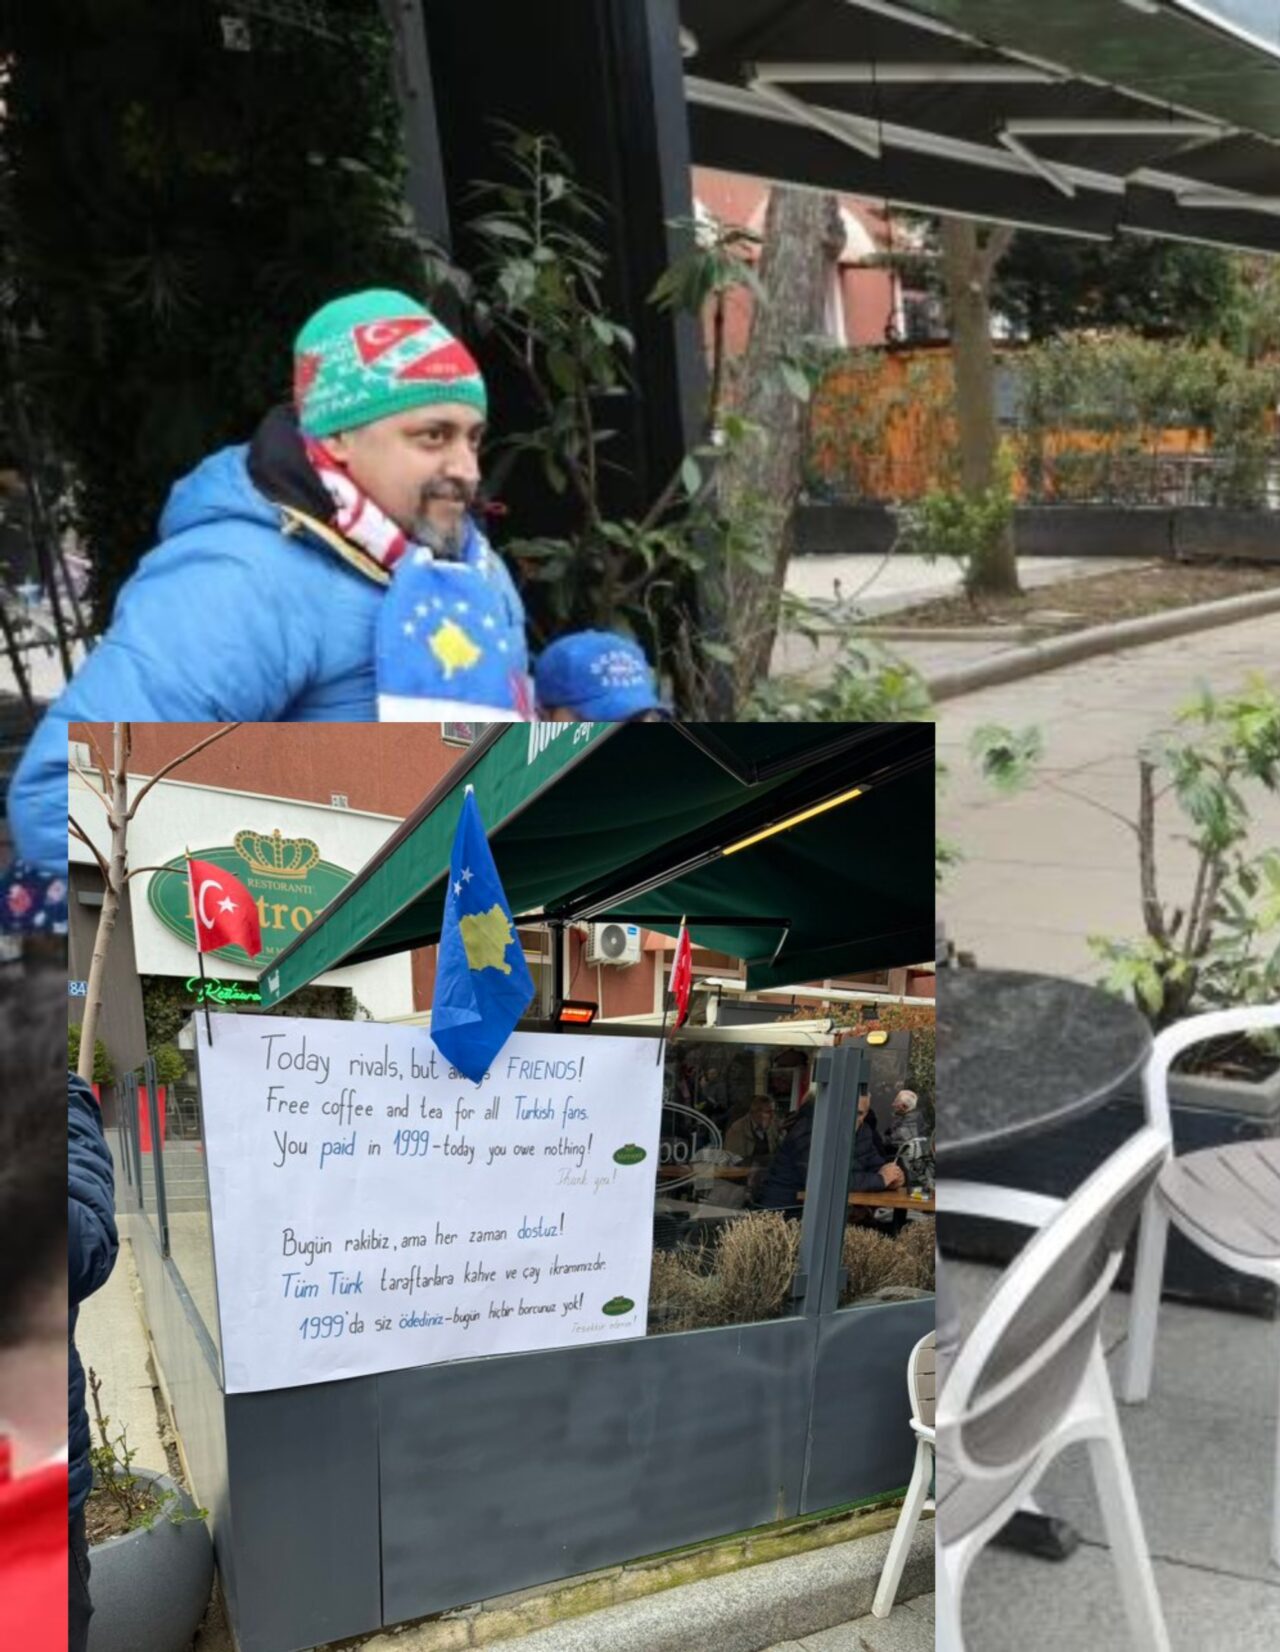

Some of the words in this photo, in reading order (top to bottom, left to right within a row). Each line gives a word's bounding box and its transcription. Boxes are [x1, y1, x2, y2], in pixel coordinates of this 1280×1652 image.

[261, 1034, 330, 1085] Today
[349, 1044, 404, 1081] rivals,
[410, 1047, 440, 1080] but
[507, 1056, 585, 1083] FRIENDS!
[266, 1085, 310, 1115] Free
[321, 1087, 374, 1126] coffee
[386, 1093, 410, 1118] and
[420, 1096, 443, 1119] tea
[455, 1096, 476, 1131] for
[484, 1096, 500, 1120] all
[515, 1095, 555, 1120] Turkish
[562, 1095, 589, 1129] fans.
[273, 1130, 308, 1168] You
[319, 1130, 357, 1170] paid
[367, 1139, 381, 1156] in
[486, 1144, 507, 1166] you
[513, 1145, 535, 1156] owe
[544, 1133, 593, 1168] nothing!
[282, 1228, 332, 1266] Bugün
[401, 1234, 427, 1248] ama
[435, 1221, 458, 1245] her
[469, 1229, 507, 1243] zaman
[517, 1212, 565, 1240] dostuz!
[282, 1271, 319, 1298] Tüm
[328, 1271, 364, 1295] Türk
[463, 1260, 496, 1284] kahve
[506, 1267, 517, 1280] ve
[523, 1266, 541, 1285] çay
[375, 1315, 392, 1332] siz
[518, 1298, 557, 1316] borcunuz
[561, 1292, 584, 1317] yok!
